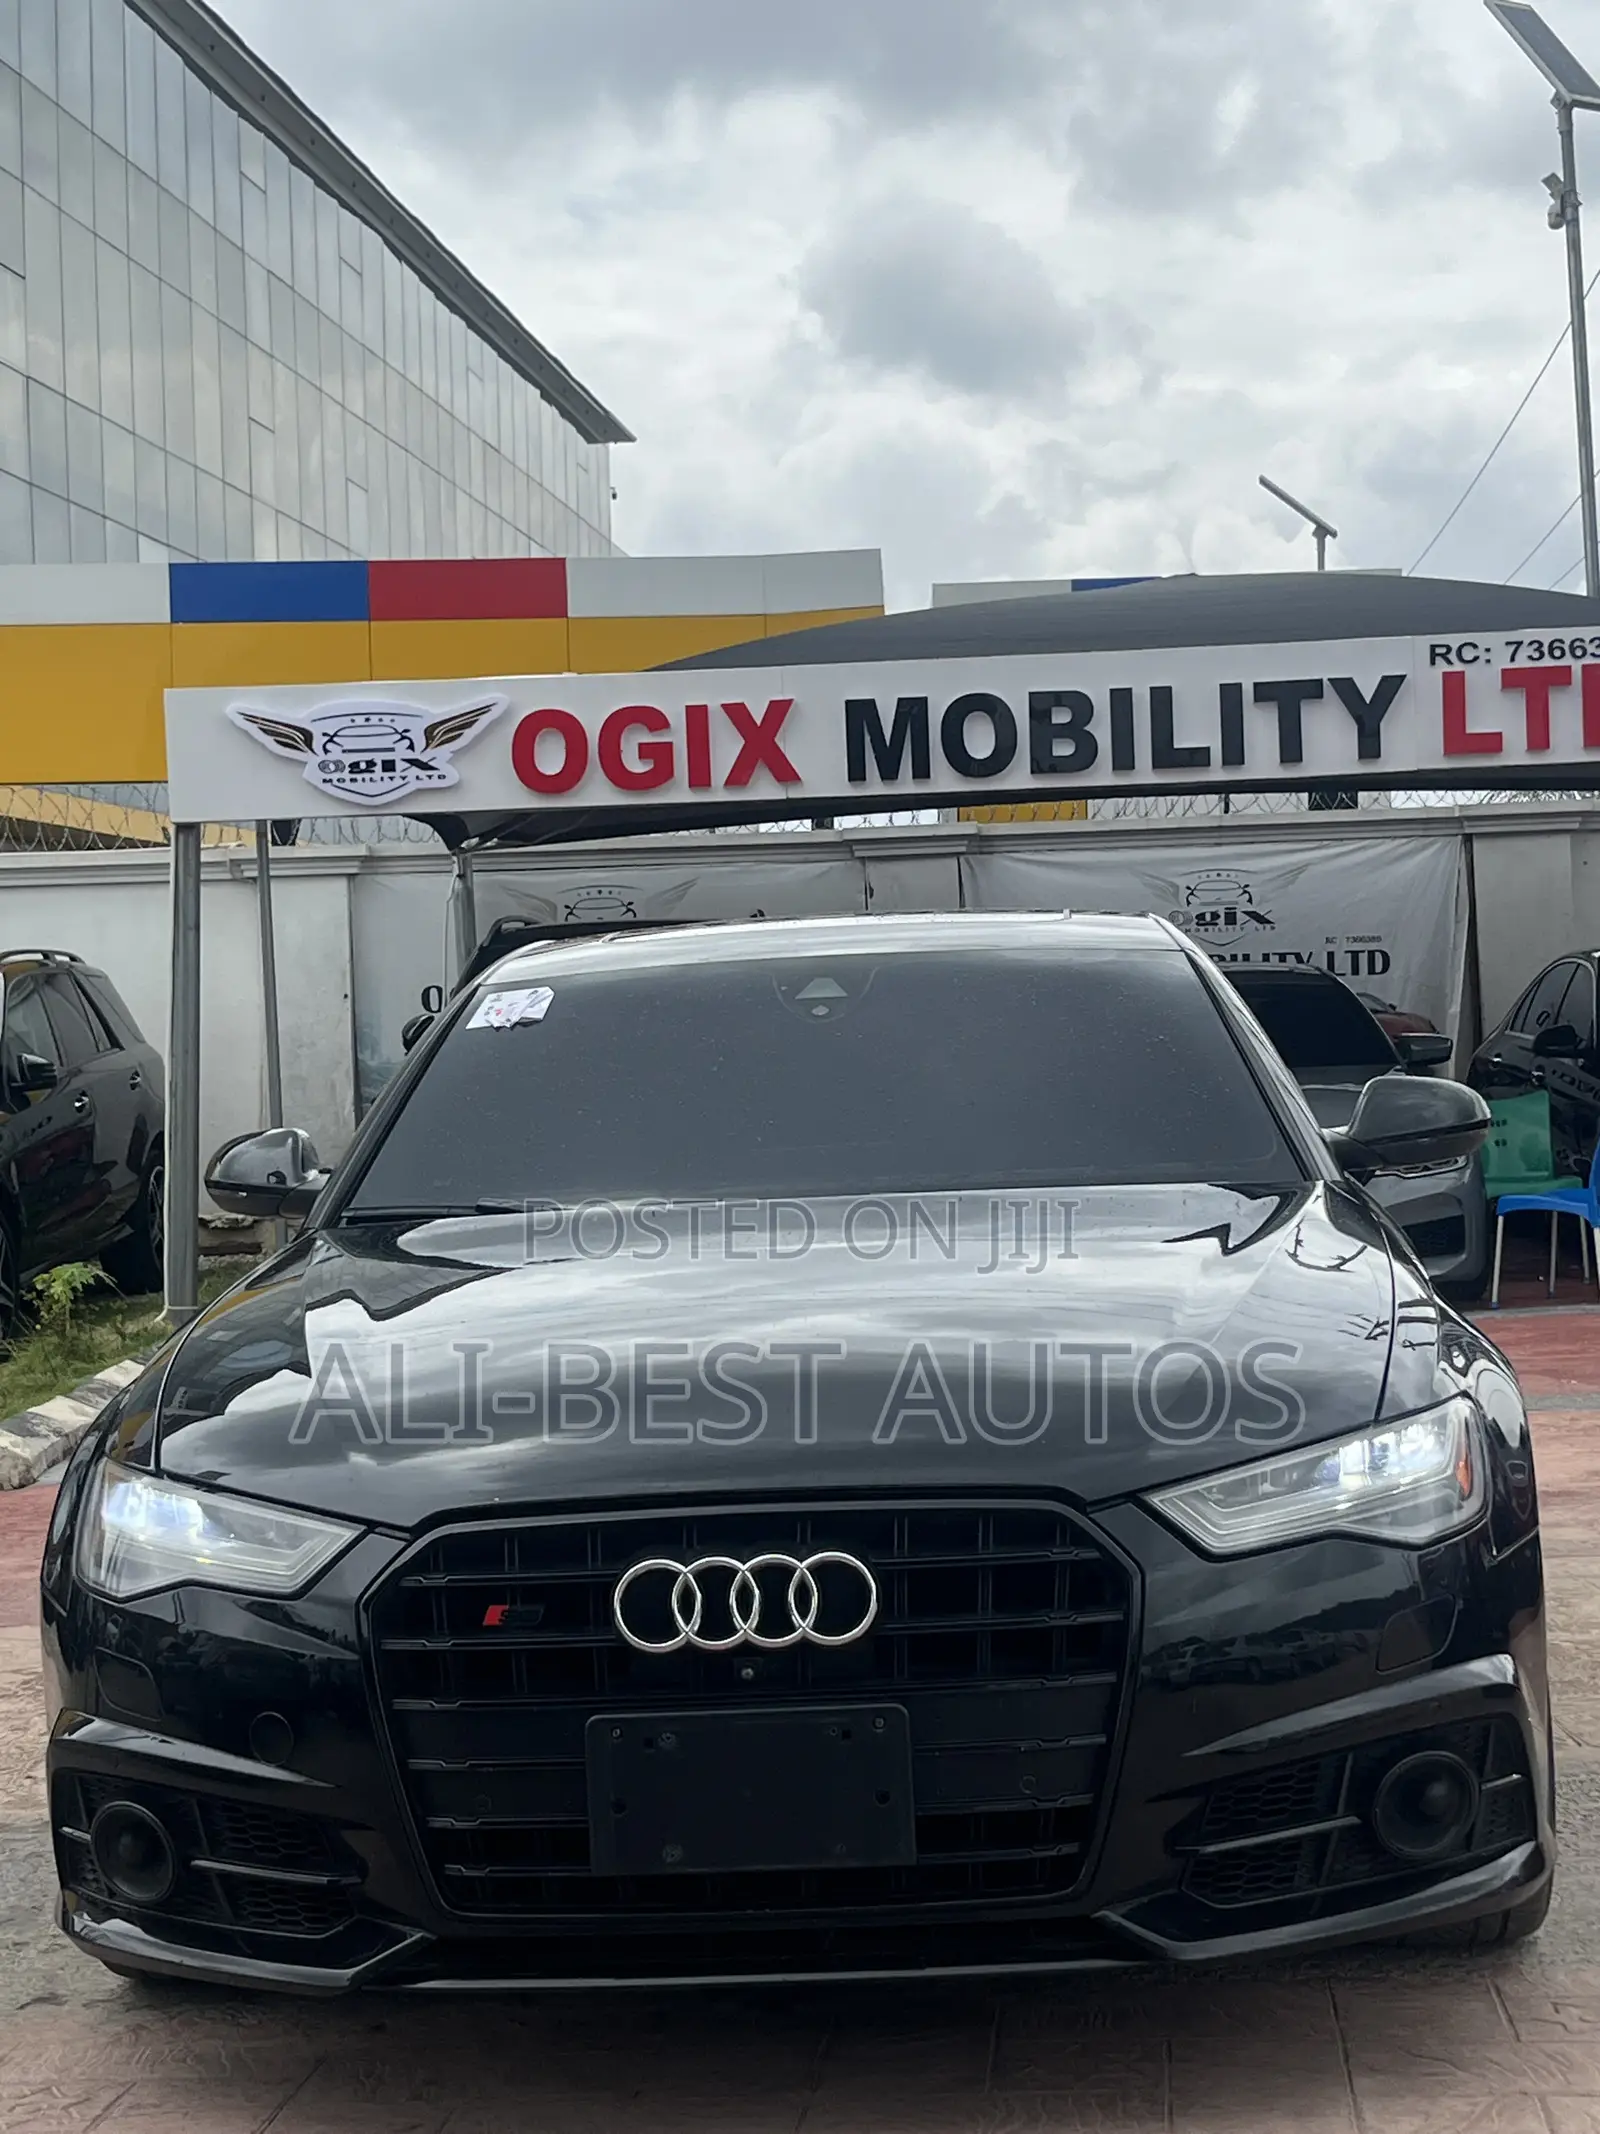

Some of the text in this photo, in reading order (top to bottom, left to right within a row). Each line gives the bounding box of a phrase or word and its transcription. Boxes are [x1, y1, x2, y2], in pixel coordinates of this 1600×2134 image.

[1429, 642, 1491, 666] RC:
[511, 698, 802, 794] OGIX
[844, 674, 1407, 782] MOBILITY
[322, 775, 409, 784] MOBILITY
[1326, 949, 1391, 977] LTD
